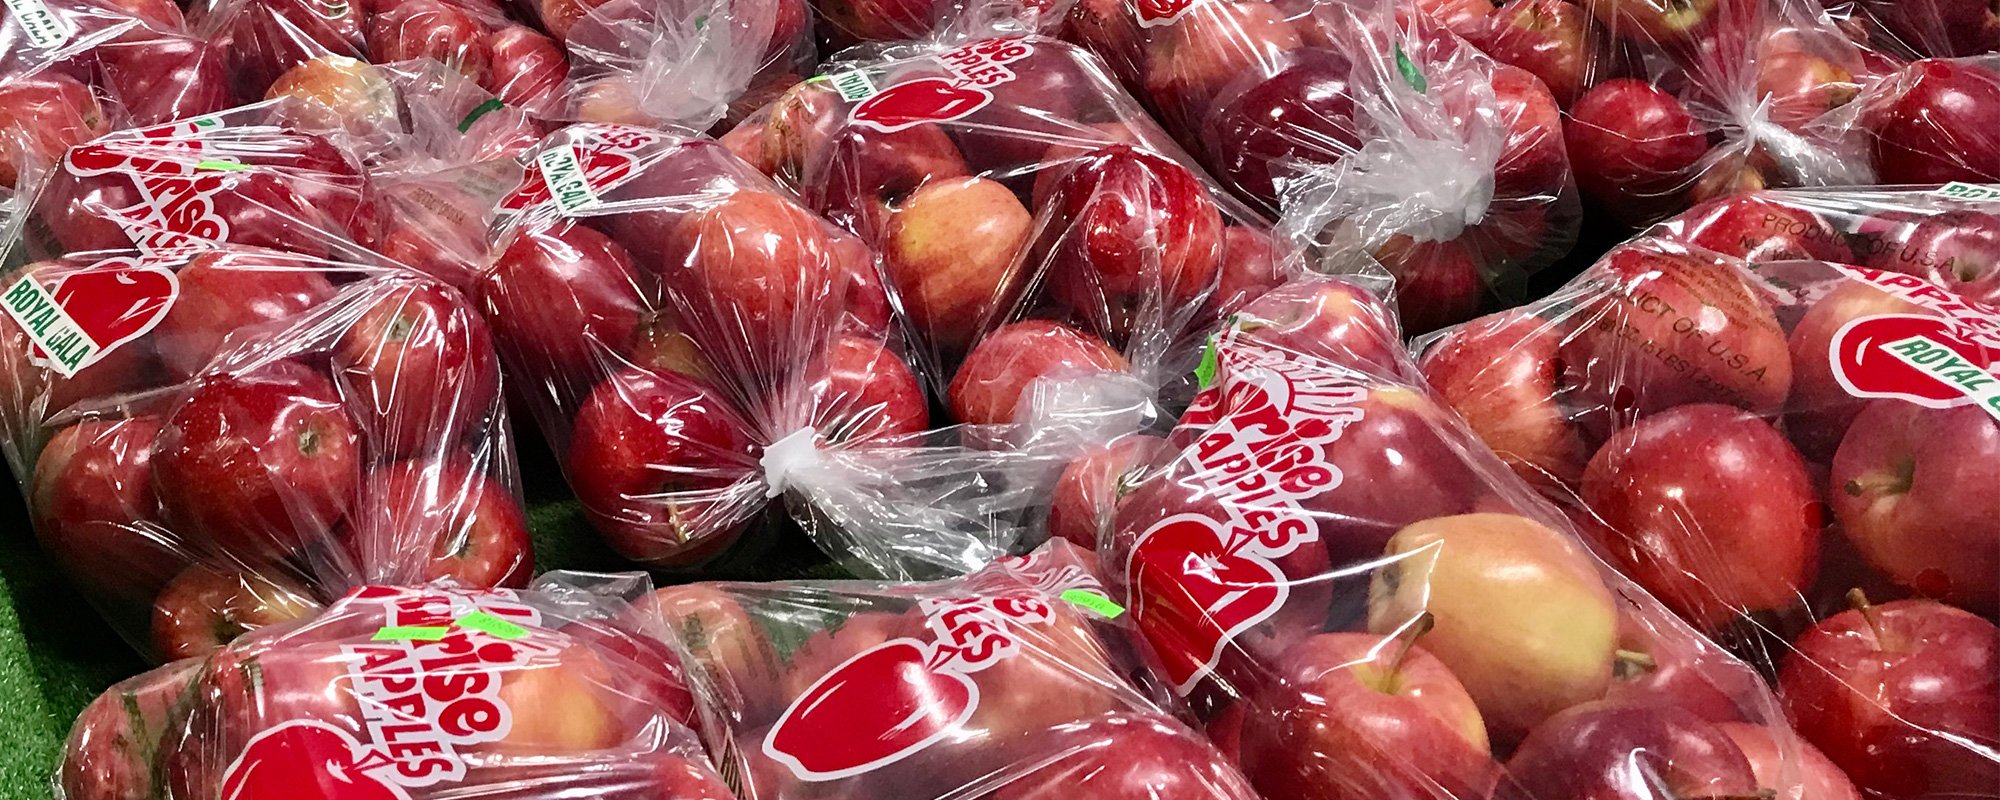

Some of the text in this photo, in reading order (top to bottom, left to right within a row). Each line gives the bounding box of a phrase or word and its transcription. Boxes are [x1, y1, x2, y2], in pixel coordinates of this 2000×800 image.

[938, 46, 1009, 85] PPLES
[1946, 184, 2000, 198] ROY
[1761, 213, 1850, 248] PRODUC
[5, 279, 91, 371] ROYAL GALA
[1891, 339, 1995, 391] ROYAL
[1197, 432, 1309, 549] APPLES
[353, 647, 454, 778] APPLES
